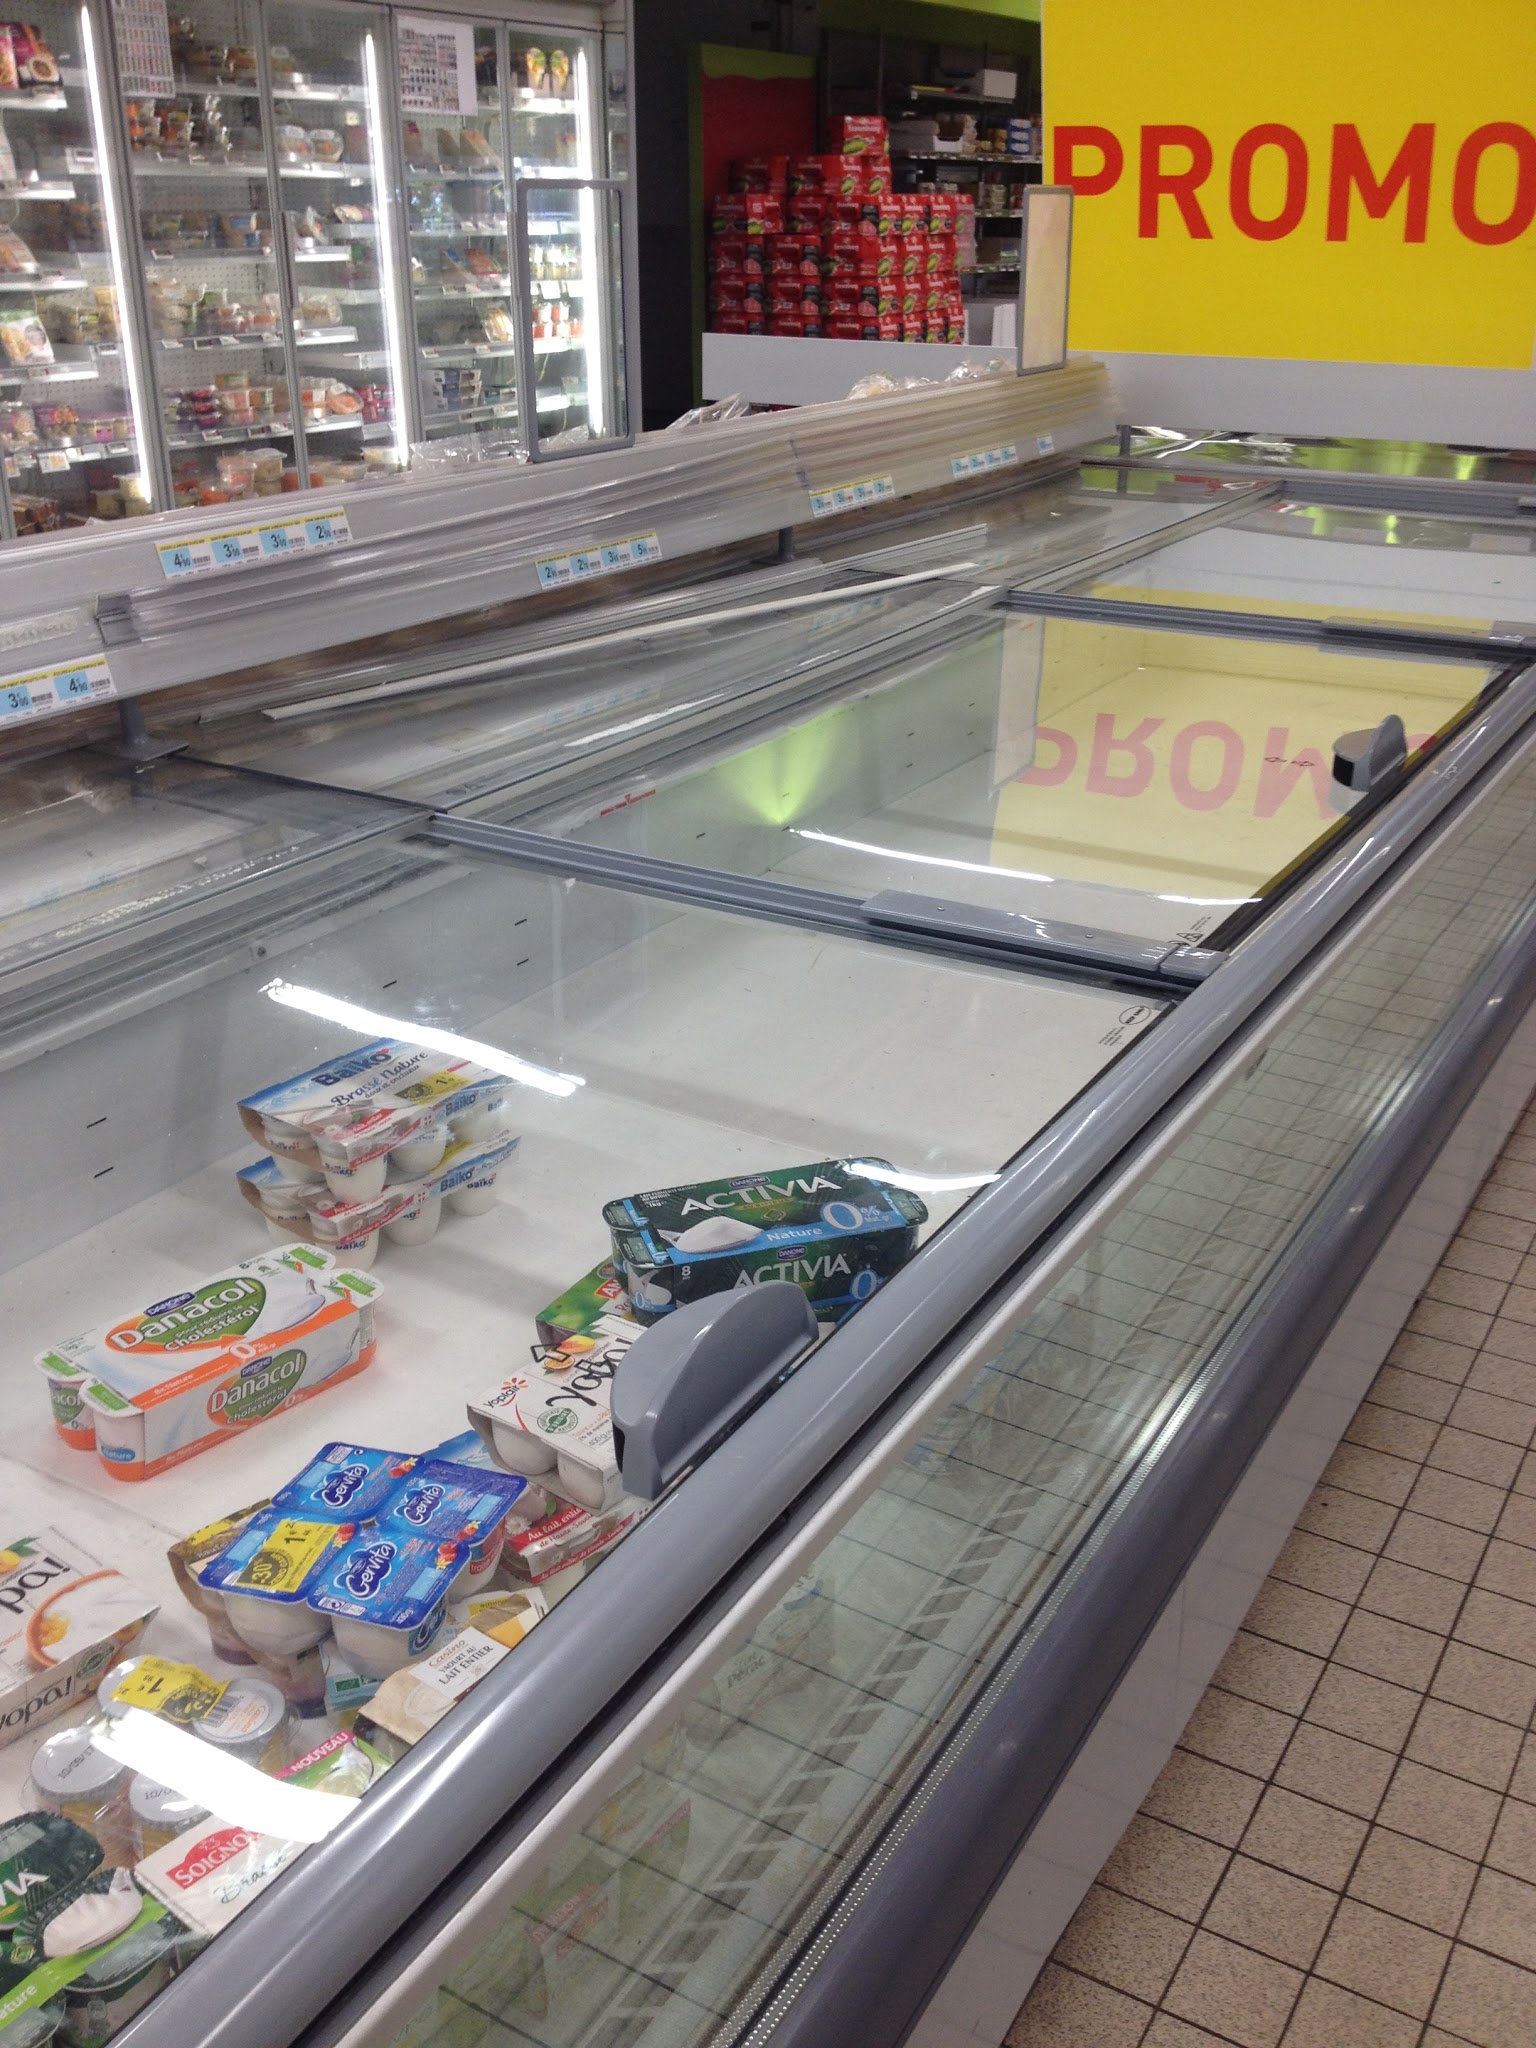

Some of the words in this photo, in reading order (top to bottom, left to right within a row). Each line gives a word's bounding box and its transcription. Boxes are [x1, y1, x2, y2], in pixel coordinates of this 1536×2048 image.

[1053, 121, 1536, 246] PROMO
[381, 1051, 429, 1080] Nature
[681, 1175, 842, 1216] ACTIVIA
[733, 1176, 768, 1187] DANONE
[767, 1226, 823, 1242] Nature
[778, 1246, 806, 1258] DANONE
[681, 1265, 691, 1276] 8
[110, 1278, 257, 1350] Danacol
[164, 1303, 259, 1352] Cholestérol
[211, 1353, 303, 1414] Danacol
[225, 1388, 288, 1425] Cholestérol
[321, 1465, 366, 1507] Gervita
[403, 1486, 441, 1525] Gervita
[527, 1529, 544, 1542] Au
[543, 1519, 562, 1534] lait
[561, 1506, 583, 1523] entie
[345, 1543, 392, 1597] Gervita
[438, 1668, 461, 1685] LAIT
[461, 1645, 494, 1670] ENTIER
[439, 1651, 466, 1673] YAOURT
[466, 1645, 477, 1655] AU
[290, 1731, 349, 1772] NOUVEAU
